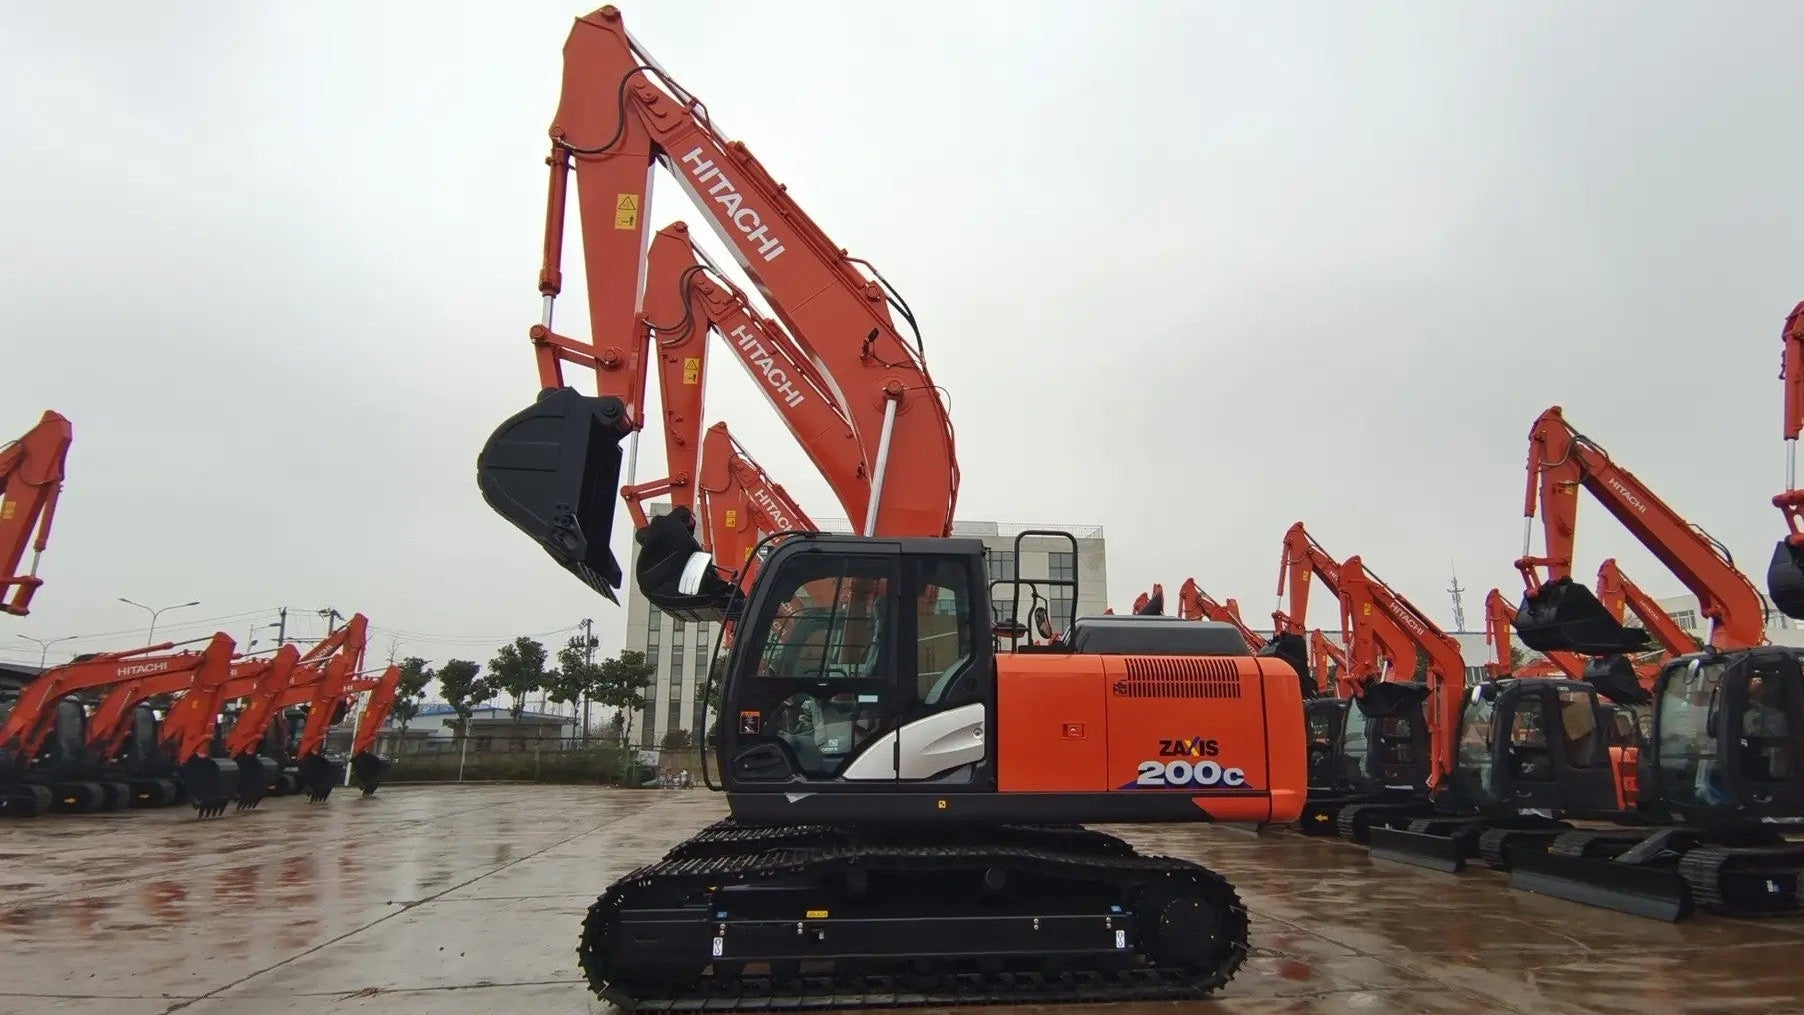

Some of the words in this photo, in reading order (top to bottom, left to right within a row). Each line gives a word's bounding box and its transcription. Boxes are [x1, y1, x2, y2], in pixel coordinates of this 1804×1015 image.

[682, 147, 786, 262] HITACHI
[730, 325, 805, 408] HITACHI
[755, 489, 793, 532] HITAC
[1609, 478, 1646, 513] HITACHI
[1389, 602, 1425, 636] HITACHI
[117, 661, 168, 677] HITACHI
[1159, 736, 1219, 757] ZAXIS
